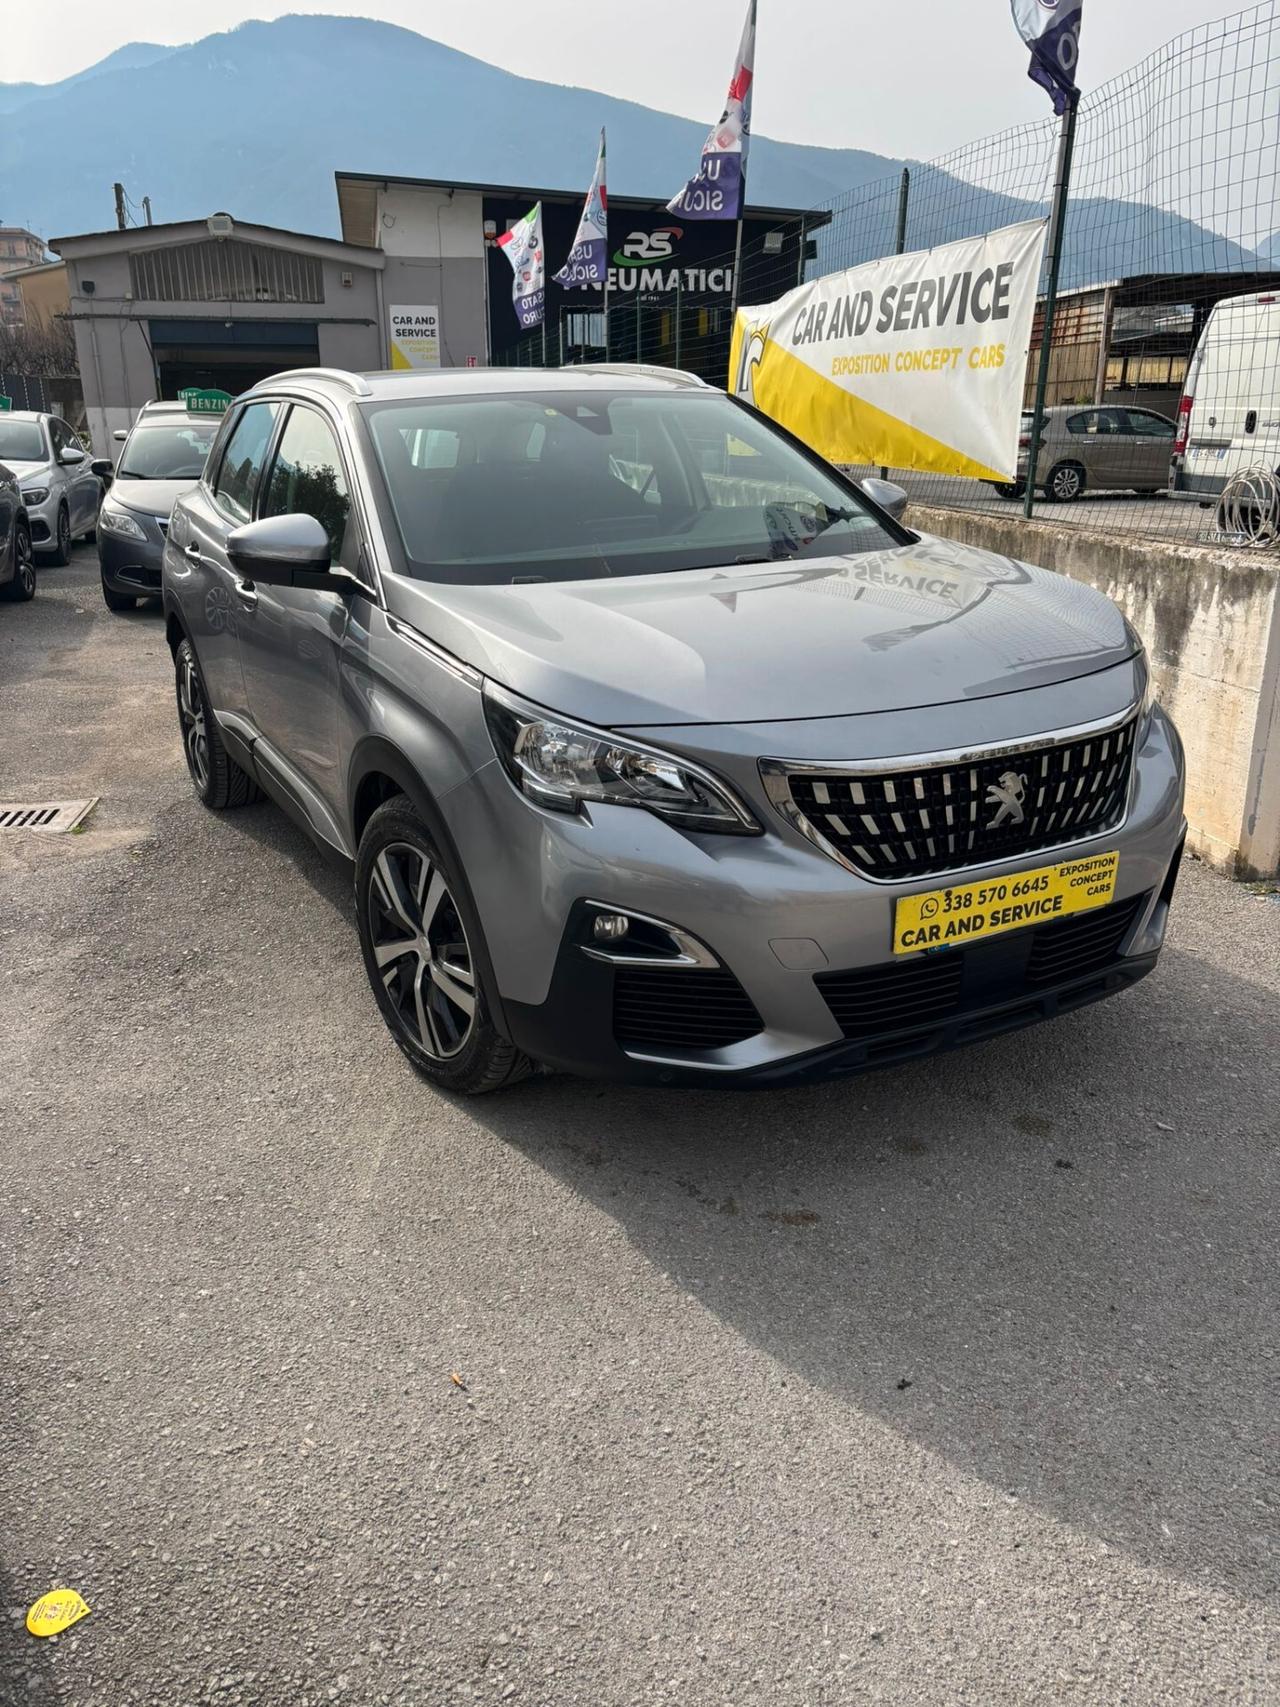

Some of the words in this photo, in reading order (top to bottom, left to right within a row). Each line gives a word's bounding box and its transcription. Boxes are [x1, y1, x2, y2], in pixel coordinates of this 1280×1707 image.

[623, 231, 673, 258] RS
[562, 268, 732, 292] EUMATICI
[792, 301, 828, 346] CAR
[826, 290, 874, 341] AND
[876, 261, 1015, 334] SERVICE
[392, 316, 413, 325] CAR
[415, 316, 436, 325] AND
[395, 328, 437, 337] SERVICE
[831, 352, 890, 376] EXPOSITION
[895, 347, 963, 371] CONCEPT
[968, 343, 1006, 369] CARS
[191, 397, 229, 409] BENZIN
[1059, 857, 1115, 877] EXPOSITION
[1070, 870, 1113, 887] CONCEPT
[1087, 883, 1111, 896] CARS
[942, 891, 973, 913] 338
[977, 885, 1007, 905] 570
[1011, 875, 1049, 898] 6645
[901, 924, 941, 947] CAR
[945, 915, 984, 938] AND
[990, 895, 1063, 927] SERVICE
